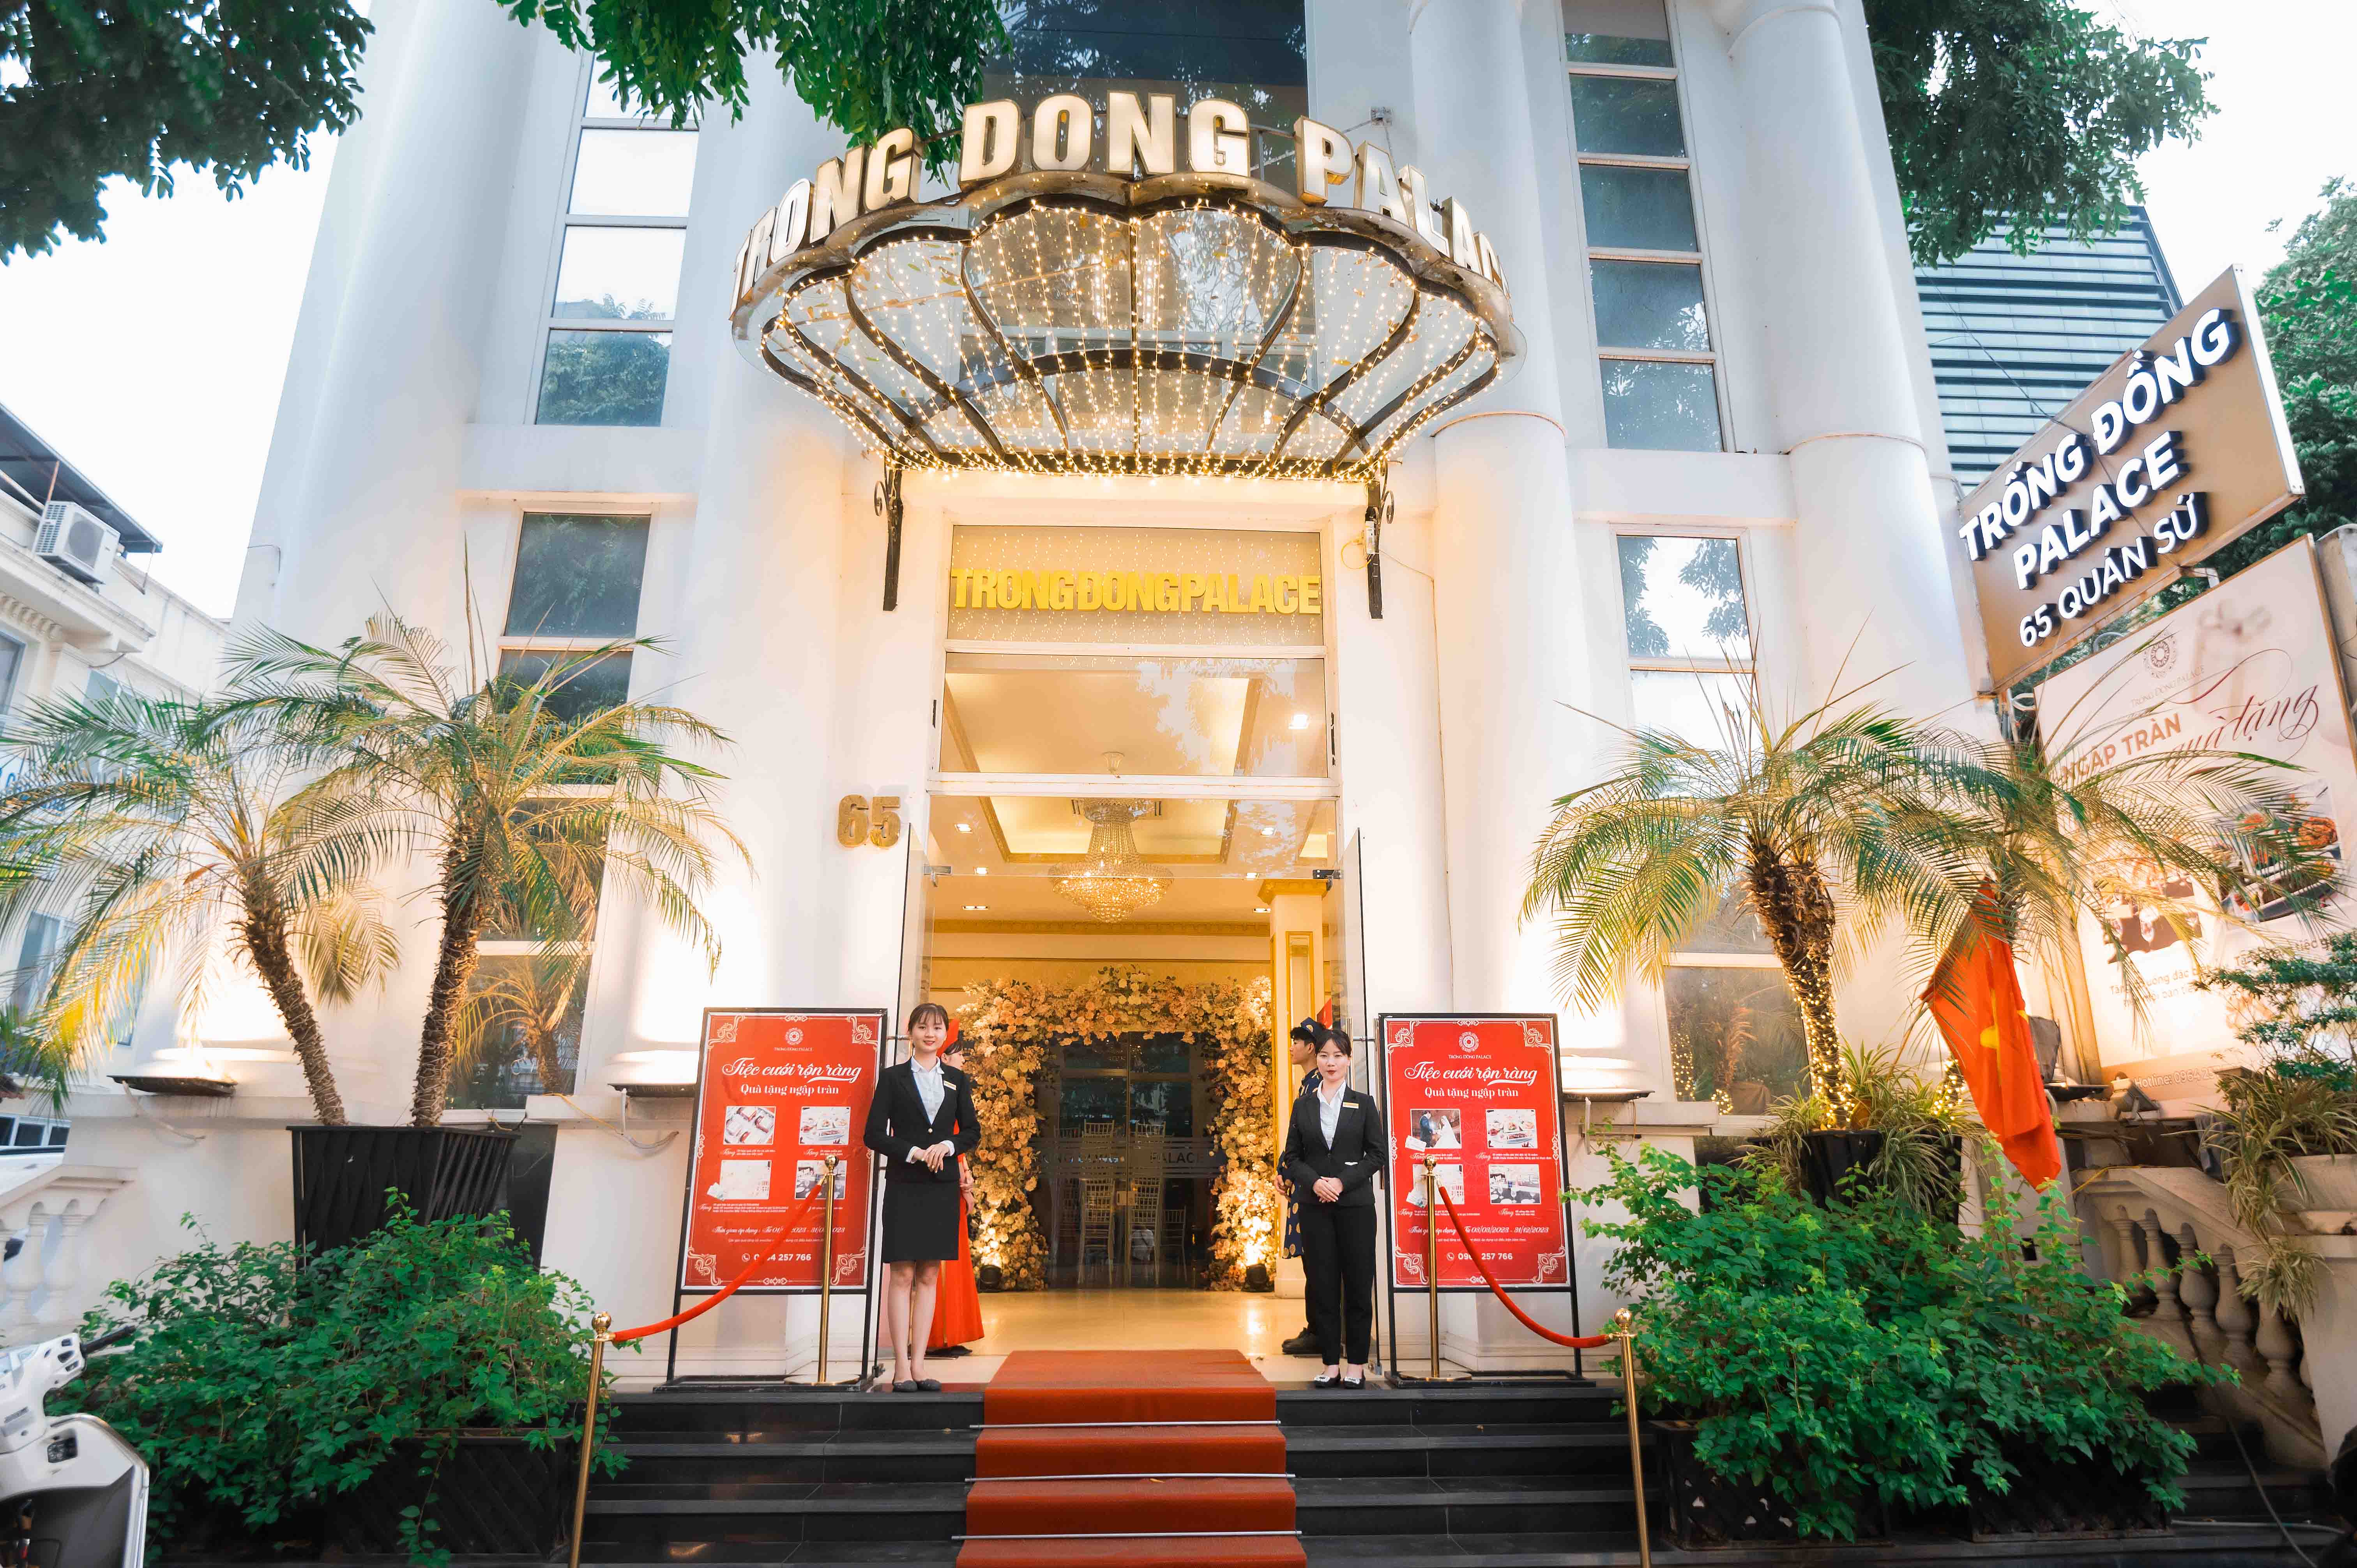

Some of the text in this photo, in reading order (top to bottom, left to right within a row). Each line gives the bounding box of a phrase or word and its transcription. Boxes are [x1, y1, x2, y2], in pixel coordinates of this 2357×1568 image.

[729, 127, 922, 320] TRONG
[958, 90, 1249, 184] DONG
[1959, 308, 2238, 560] TRỐNG ĐỒNG
[2013, 430, 2186, 590] PALACE
[2019, 492, 2201, 648] 65 QUÁN SỨ
[2121, 713, 2181, 755] TRÀN
[838, 794, 900, 848] 65
[722, 1057, 862, 1084] Tiệc cưới rộn ràng
[1404, 1061, 1537, 1086] Tiệc cưới rộn ràng
[2134, 1073, 2172, 1088] Hotline:
[2173, 1068, 2200, 1083] 0964
[740, 1084, 839, 1097] Quà tặng ngập tràn
[1425, 1087, 1519, 1099] Quà tặng ngập tràn
[778, 1253, 794, 1261] 257
[796, 1253, 812, 1261] 766
